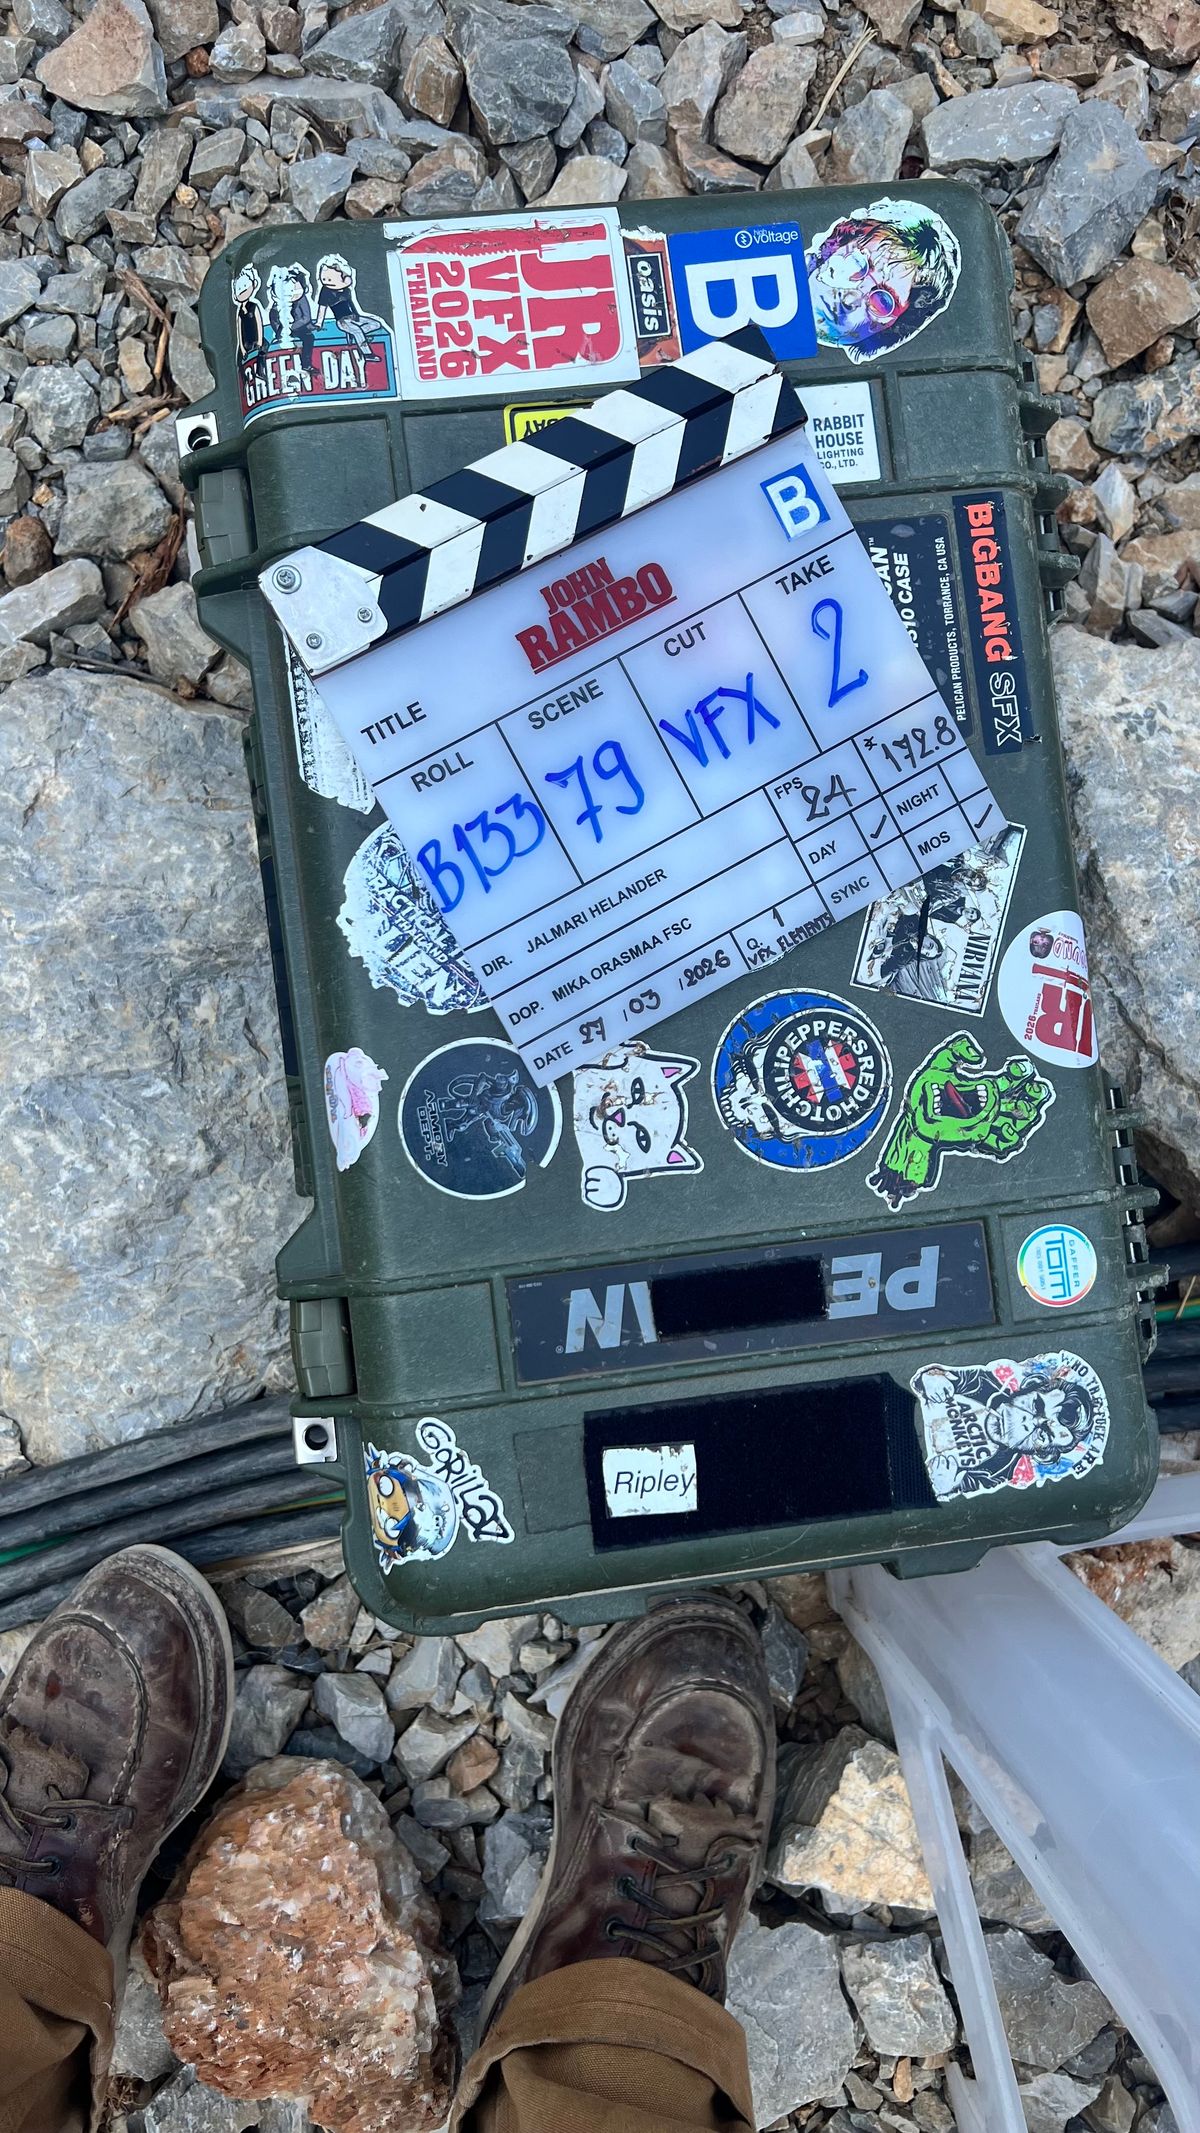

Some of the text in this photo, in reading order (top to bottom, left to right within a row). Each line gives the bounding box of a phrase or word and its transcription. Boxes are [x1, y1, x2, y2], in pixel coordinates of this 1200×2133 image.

[753, 231, 799, 244] voltage
[428, 260, 477, 378] 2026
[469, 255, 531, 374] VFX
[520, 253, 622, 369] JR
[637, 260, 662, 331] oasis
[685, 254, 799, 337] B
[406, 263, 438, 380] THAILAND
[321, 349, 367, 391] DAY
[813, 414, 864, 432] RABBIT
[815, 431, 864, 449] HOUSE
[817, 448, 864, 460] LIGHTING
[838, 459, 858, 468] LTD.
[766, 475, 821, 538] B
[540, 557, 615, 613] JOHN
[775, 555, 835, 595] TAKE
[893, 552, 912, 603] CASE
[515, 562, 674, 670] RAMBO
[664, 622, 708, 657] CUT
[934, 536, 966, 721] PELICAN PRODUCTS, TORRANCE, CA USA
[811, 598, 868, 708] 2
[361, 702, 427, 745] TITLE
[528, 679, 604, 730] SCENE
[659, 672, 780, 767] VFX
[990, 672, 1022, 747] SFX
[411, 752, 474, 792] ROLL
[545, 740, 644, 844] 79
[774, 777, 803, 800] FPS
[801, 774, 857, 822] 24
[896, 784, 940, 815] NIGHT
[417, 793, 545, 914] B133
[809, 840, 838, 864] DAY
[917, 831, 951, 856] MOS
[831, 875, 870, 904] SYNC
[481, 955, 513, 977] DIR.
[526, 911, 589, 953] JALMARI
[588, 868, 667, 918] HELANDER
[771, 906, 785, 927] 1
[746, 937, 763, 952] Q.
[747, 945, 779, 967] VFX
[955, 931, 991, 1000] NIRVANA
[508, 917, 692, 1026] DOP. MIKA ORASMAA FSC
[1024, 1015, 1037, 1041] 2026
[533, 1041, 574, 1070] DATE
[853, 1054, 875, 1102] RED
[416, 1105, 435, 1161] DEPT.
[424, 1089, 448, 1167] ARMORY
[810, 1095, 863, 1123] HOT
[957, 1401, 991, 1462] ARCTIC
[1072, 1444, 1101, 1475] ARE
[614, 1469, 695, 1499] Ripley
